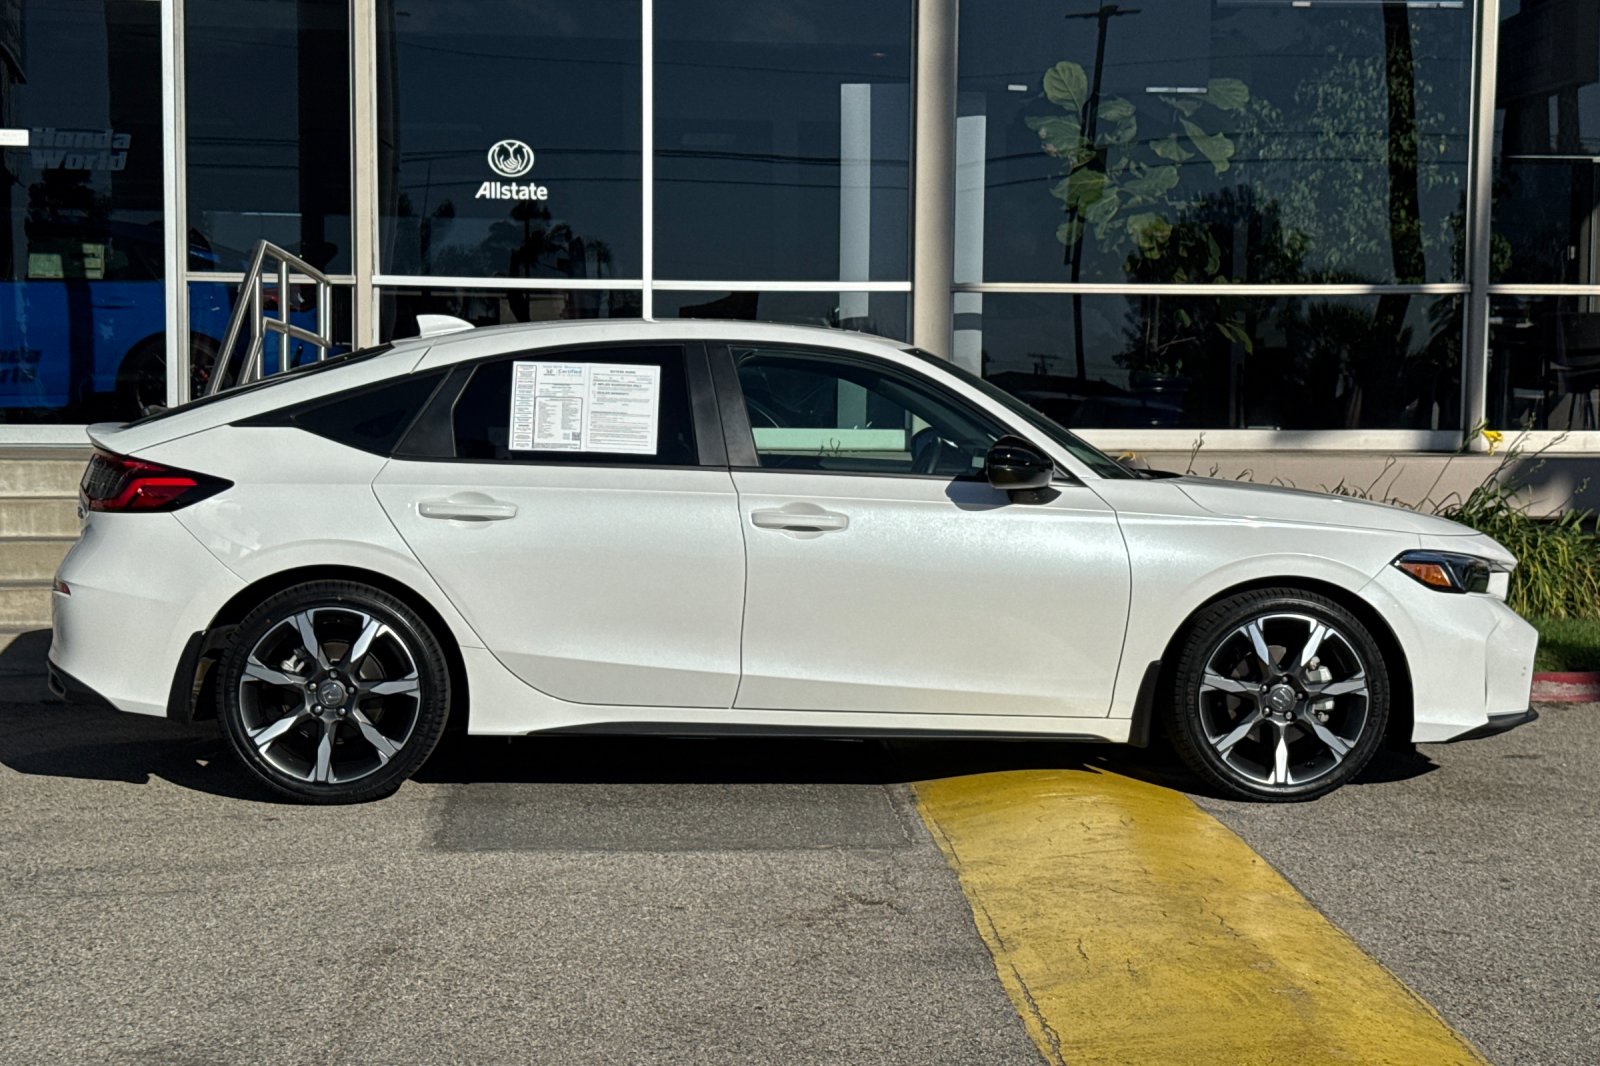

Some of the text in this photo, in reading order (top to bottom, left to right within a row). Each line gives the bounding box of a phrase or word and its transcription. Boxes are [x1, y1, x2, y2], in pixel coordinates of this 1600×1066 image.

[31, 128, 131, 149] Honda
[31, 149, 128, 171] World
[475, 181, 548, 200] Allstate
